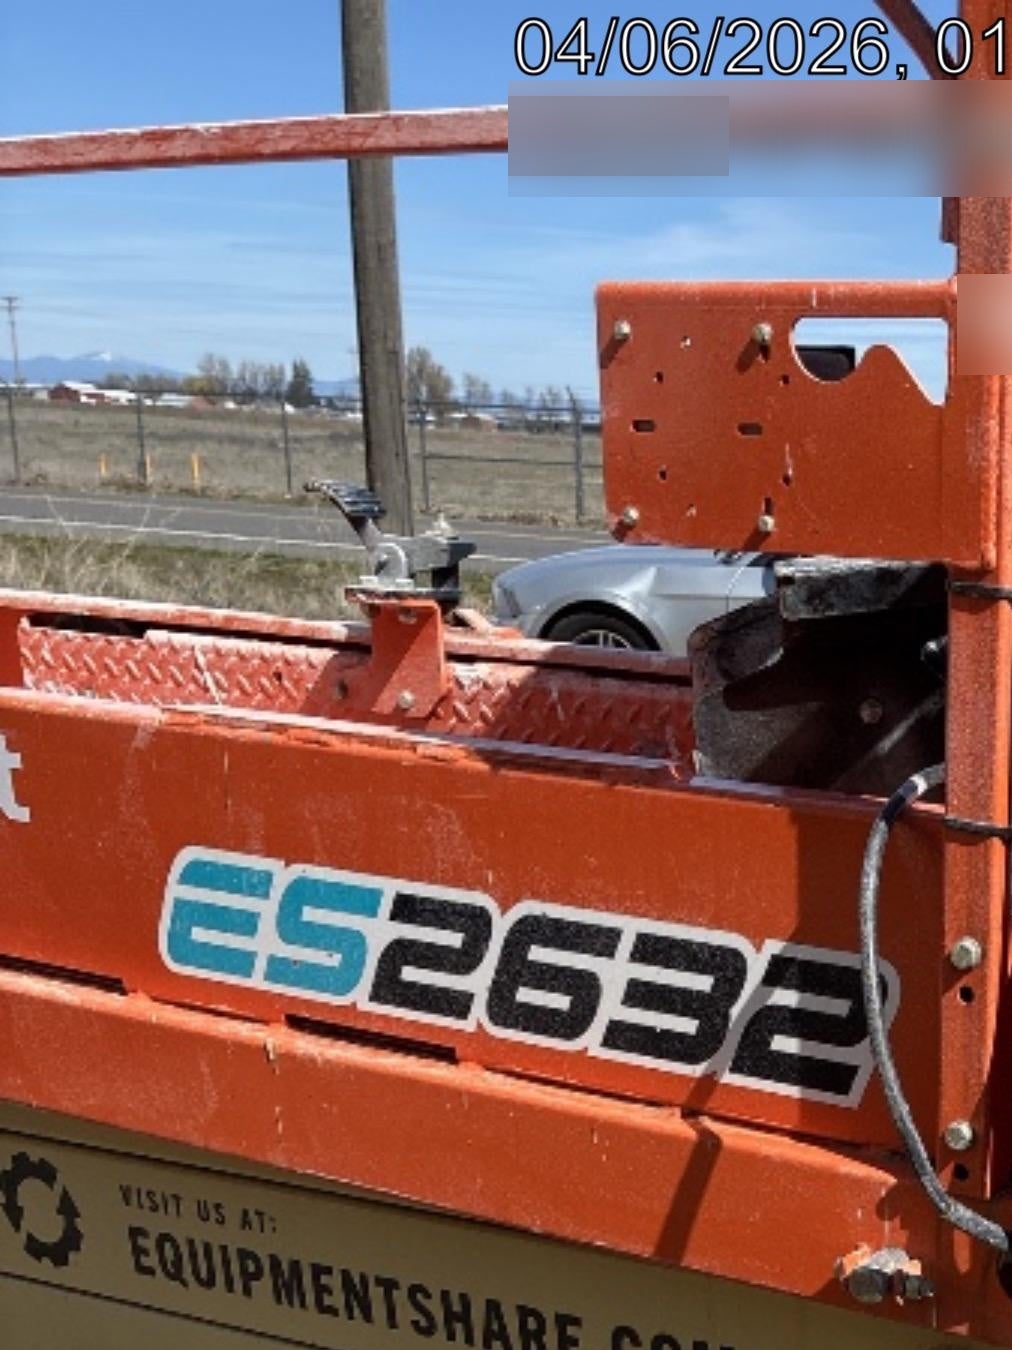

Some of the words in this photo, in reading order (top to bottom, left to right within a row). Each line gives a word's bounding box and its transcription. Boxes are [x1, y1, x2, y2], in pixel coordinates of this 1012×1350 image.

[163, 855, 890, 1099] ES2632
[119, 1183, 183, 1217] VISIT
[197, 1199, 226, 1226] US
[240, 1208, 277, 1233] AT:
